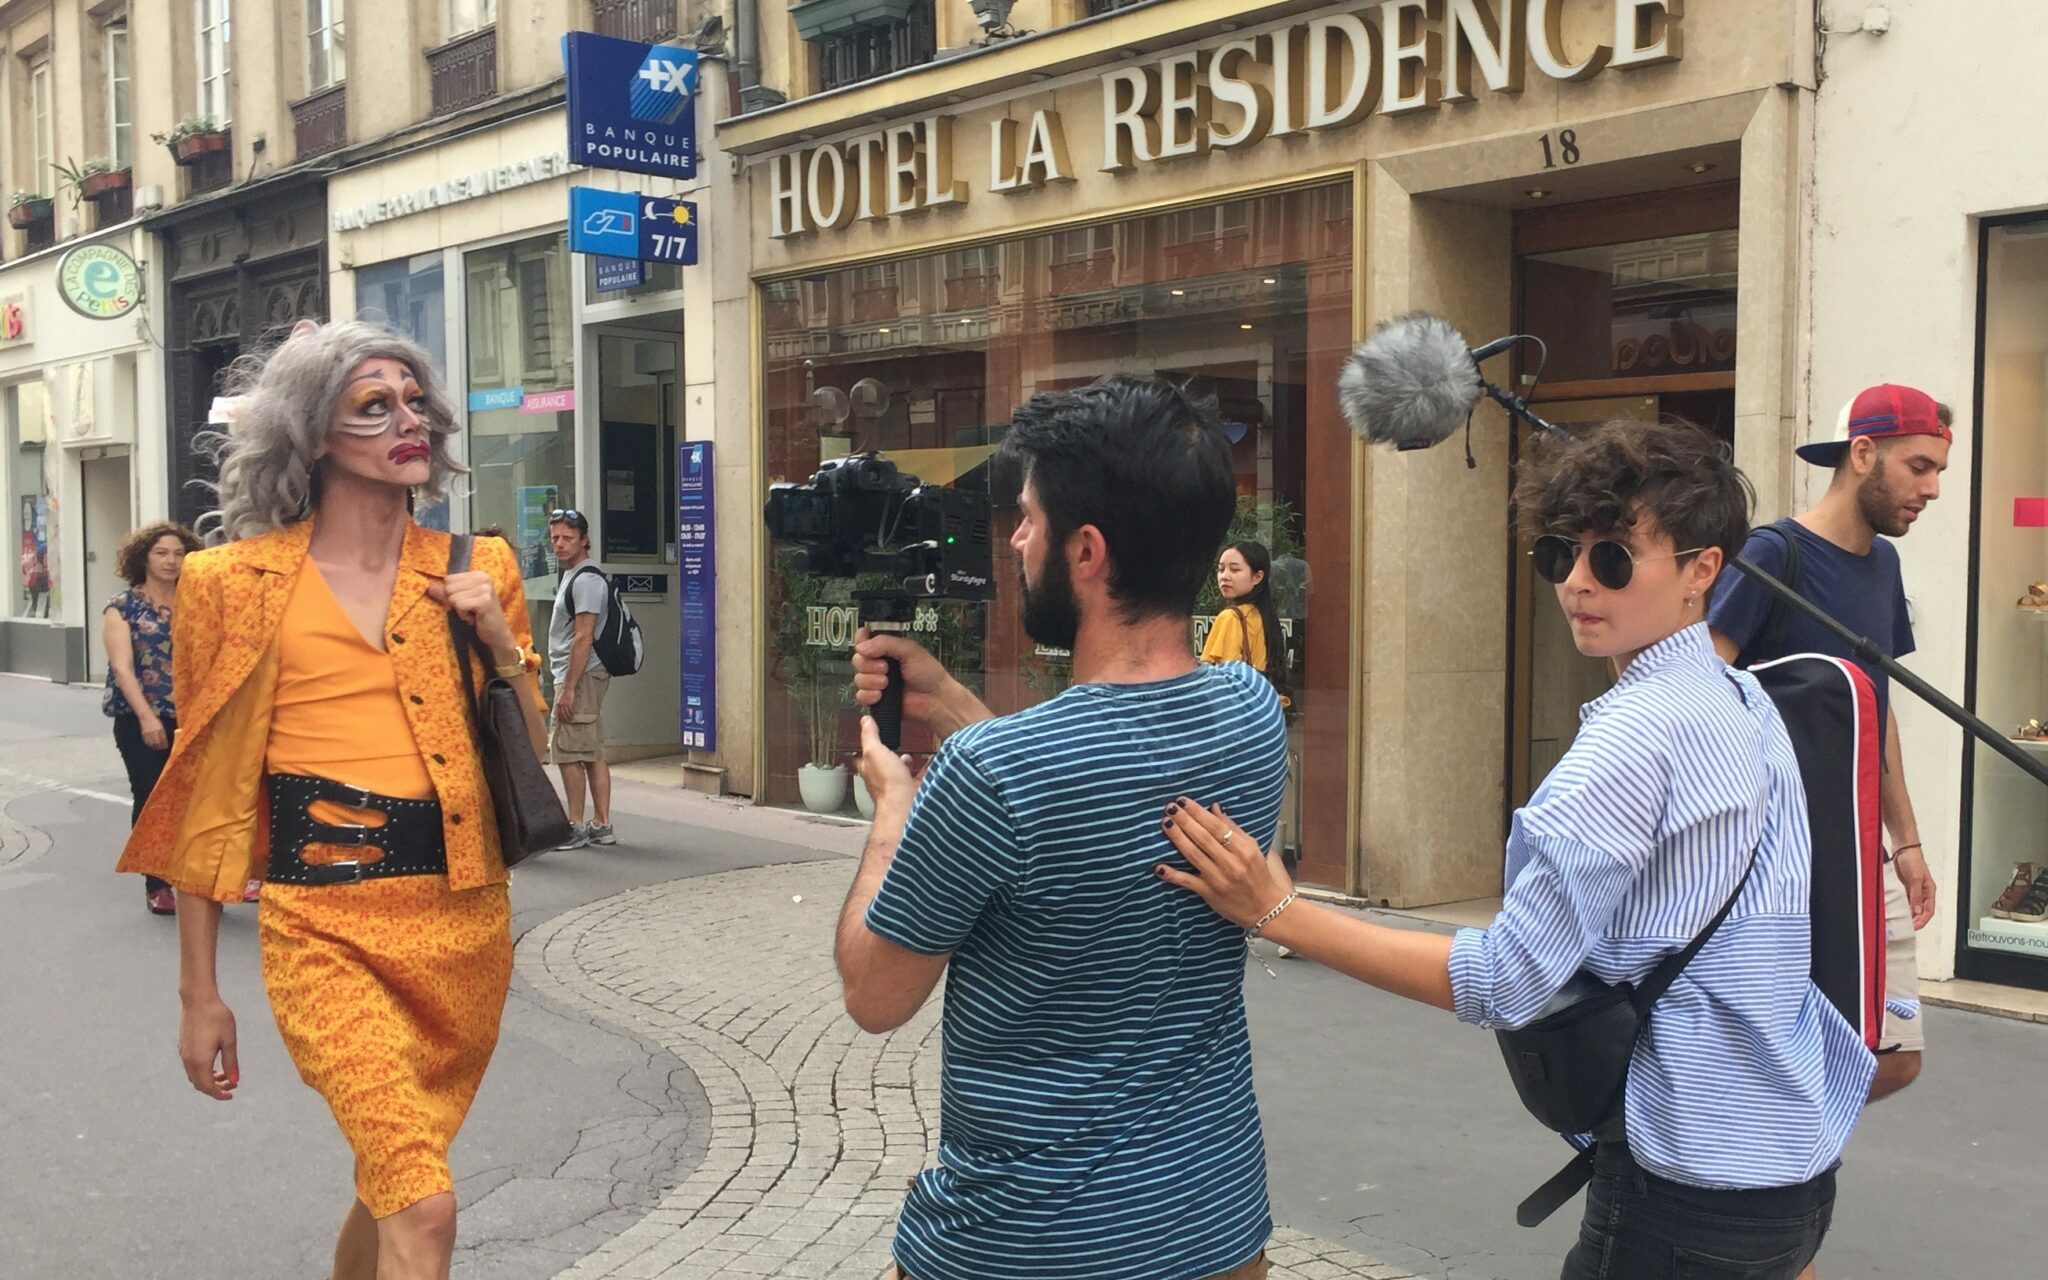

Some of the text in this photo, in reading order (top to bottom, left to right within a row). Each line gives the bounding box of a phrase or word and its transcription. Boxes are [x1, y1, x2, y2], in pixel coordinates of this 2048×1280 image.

[769, 0, 1684, 239] HOTEL LA RESIDENCE
[586, 123, 690, 149] BANQUE
[1537, 129, 1580, 169] 18
[587, 142, 690, 168] POPULAIRE
[651, 234, 687, 260] 7/7
[598, 260, 637, 275] BANQUE
[599, 272, 638, 287] POPULAIRE
[485, 390, 516, 405] BANQUE
[527, 395, 566, 409] ASSURANCE
